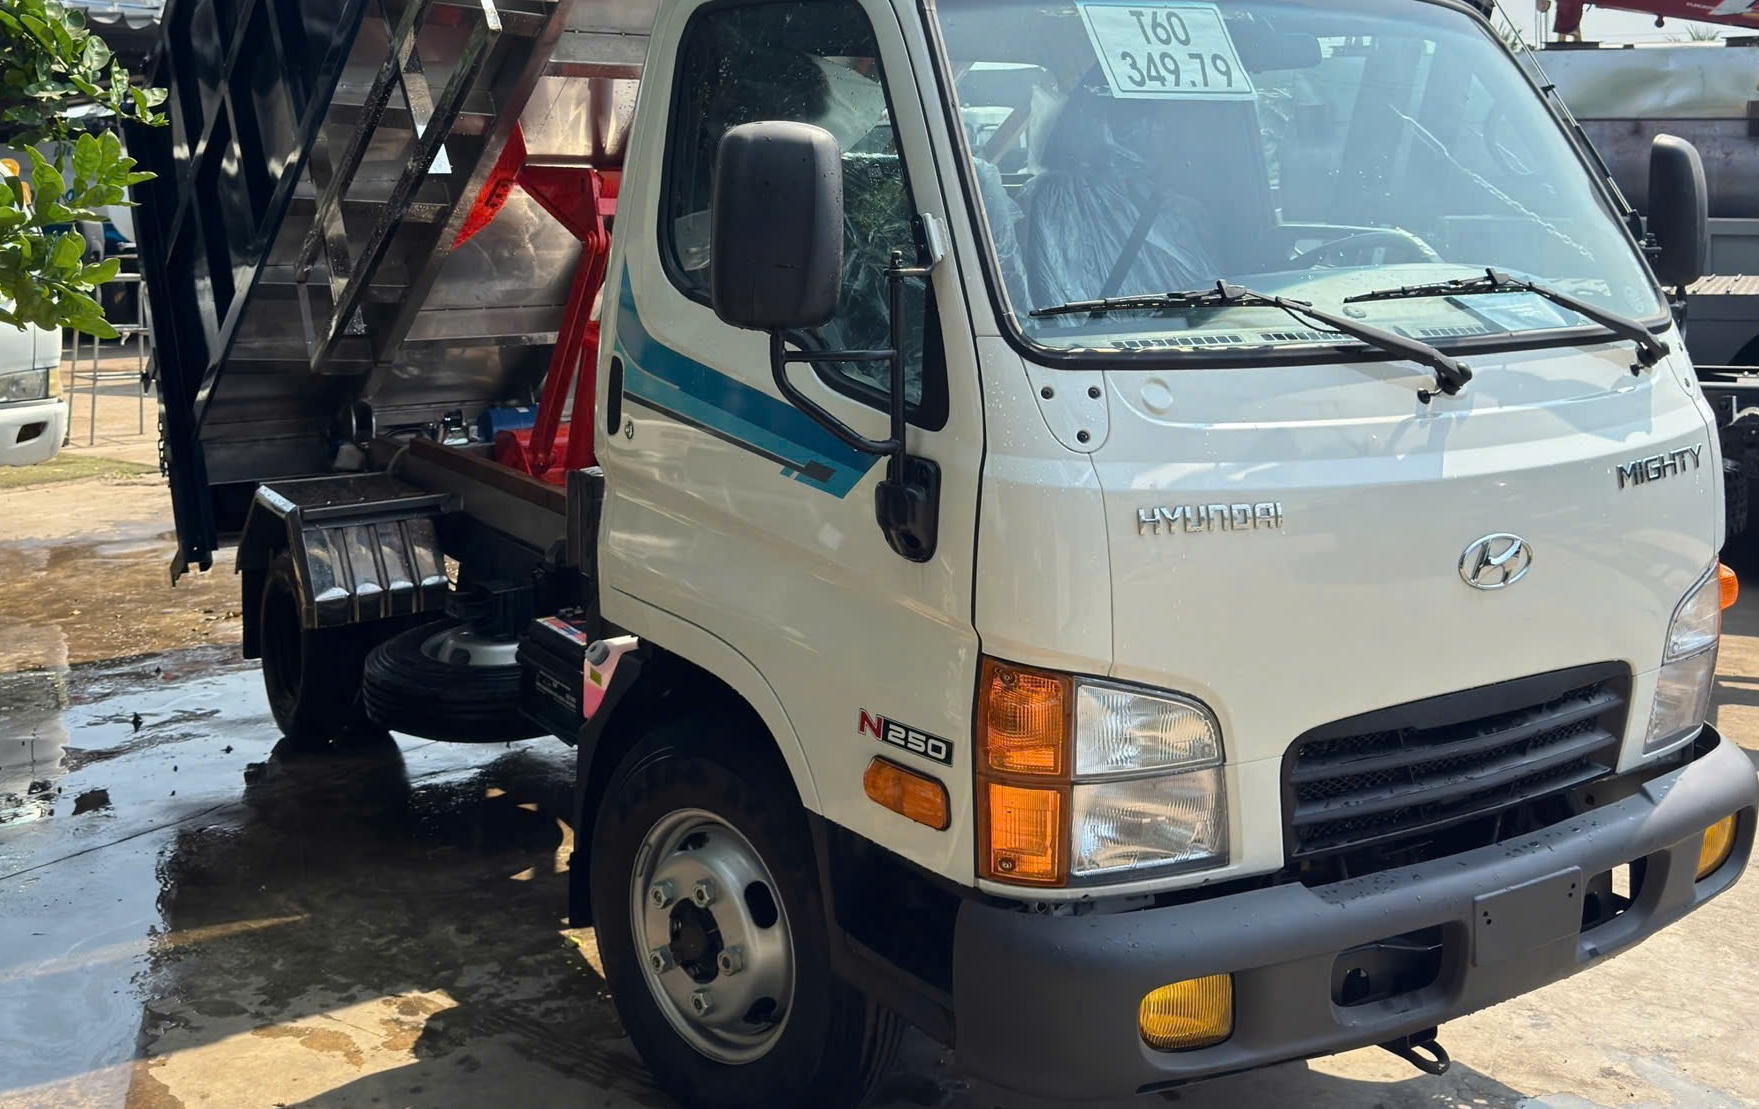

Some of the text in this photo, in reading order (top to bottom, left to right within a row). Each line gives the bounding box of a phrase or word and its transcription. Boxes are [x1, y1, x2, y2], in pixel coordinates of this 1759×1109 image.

[1128, 10, 1191, 46] T60
[1120, 50, 1233, 88] 349.79
[1616, 443, 1702, 490] MIGHTY
[1137, 502, 1283, 536] HYUNDAI
[858, 707, 947, 760] N250
